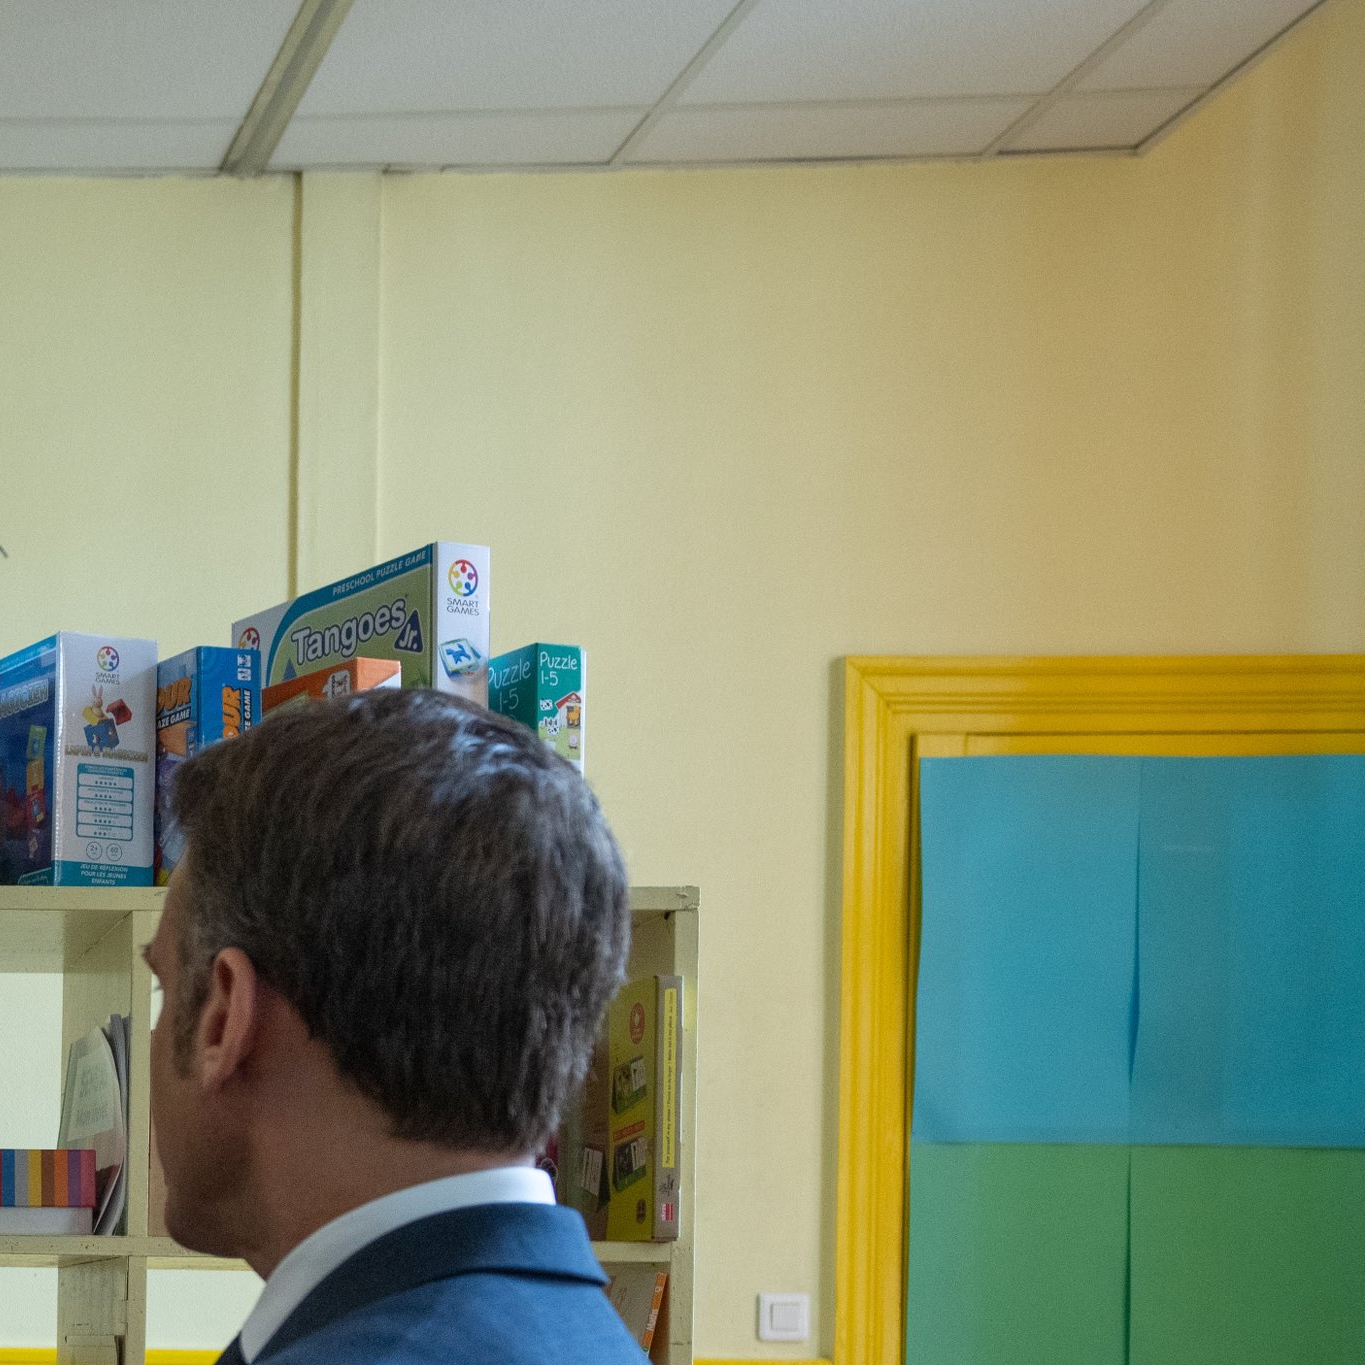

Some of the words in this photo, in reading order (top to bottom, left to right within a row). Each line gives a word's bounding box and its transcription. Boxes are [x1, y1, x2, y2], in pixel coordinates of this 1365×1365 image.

[332, 574, 375, 597] PRESCHOOL
[375, 560, 404, 579] PUZZLE
[405, 550, 426, 567] GAME
[446, 598, 479, 608] SMART
[446, 606, 479, 616] GAMES
[291, 598, 407, 664] Tangoes
[398, 625, 417, 649] Jr.
[540, 651, 578, 671] Puzzle
[541, 670, 558, 686] 1-5
[500, 688, 519, 712] 1-5
[170, 707, 190, 725] GAME
